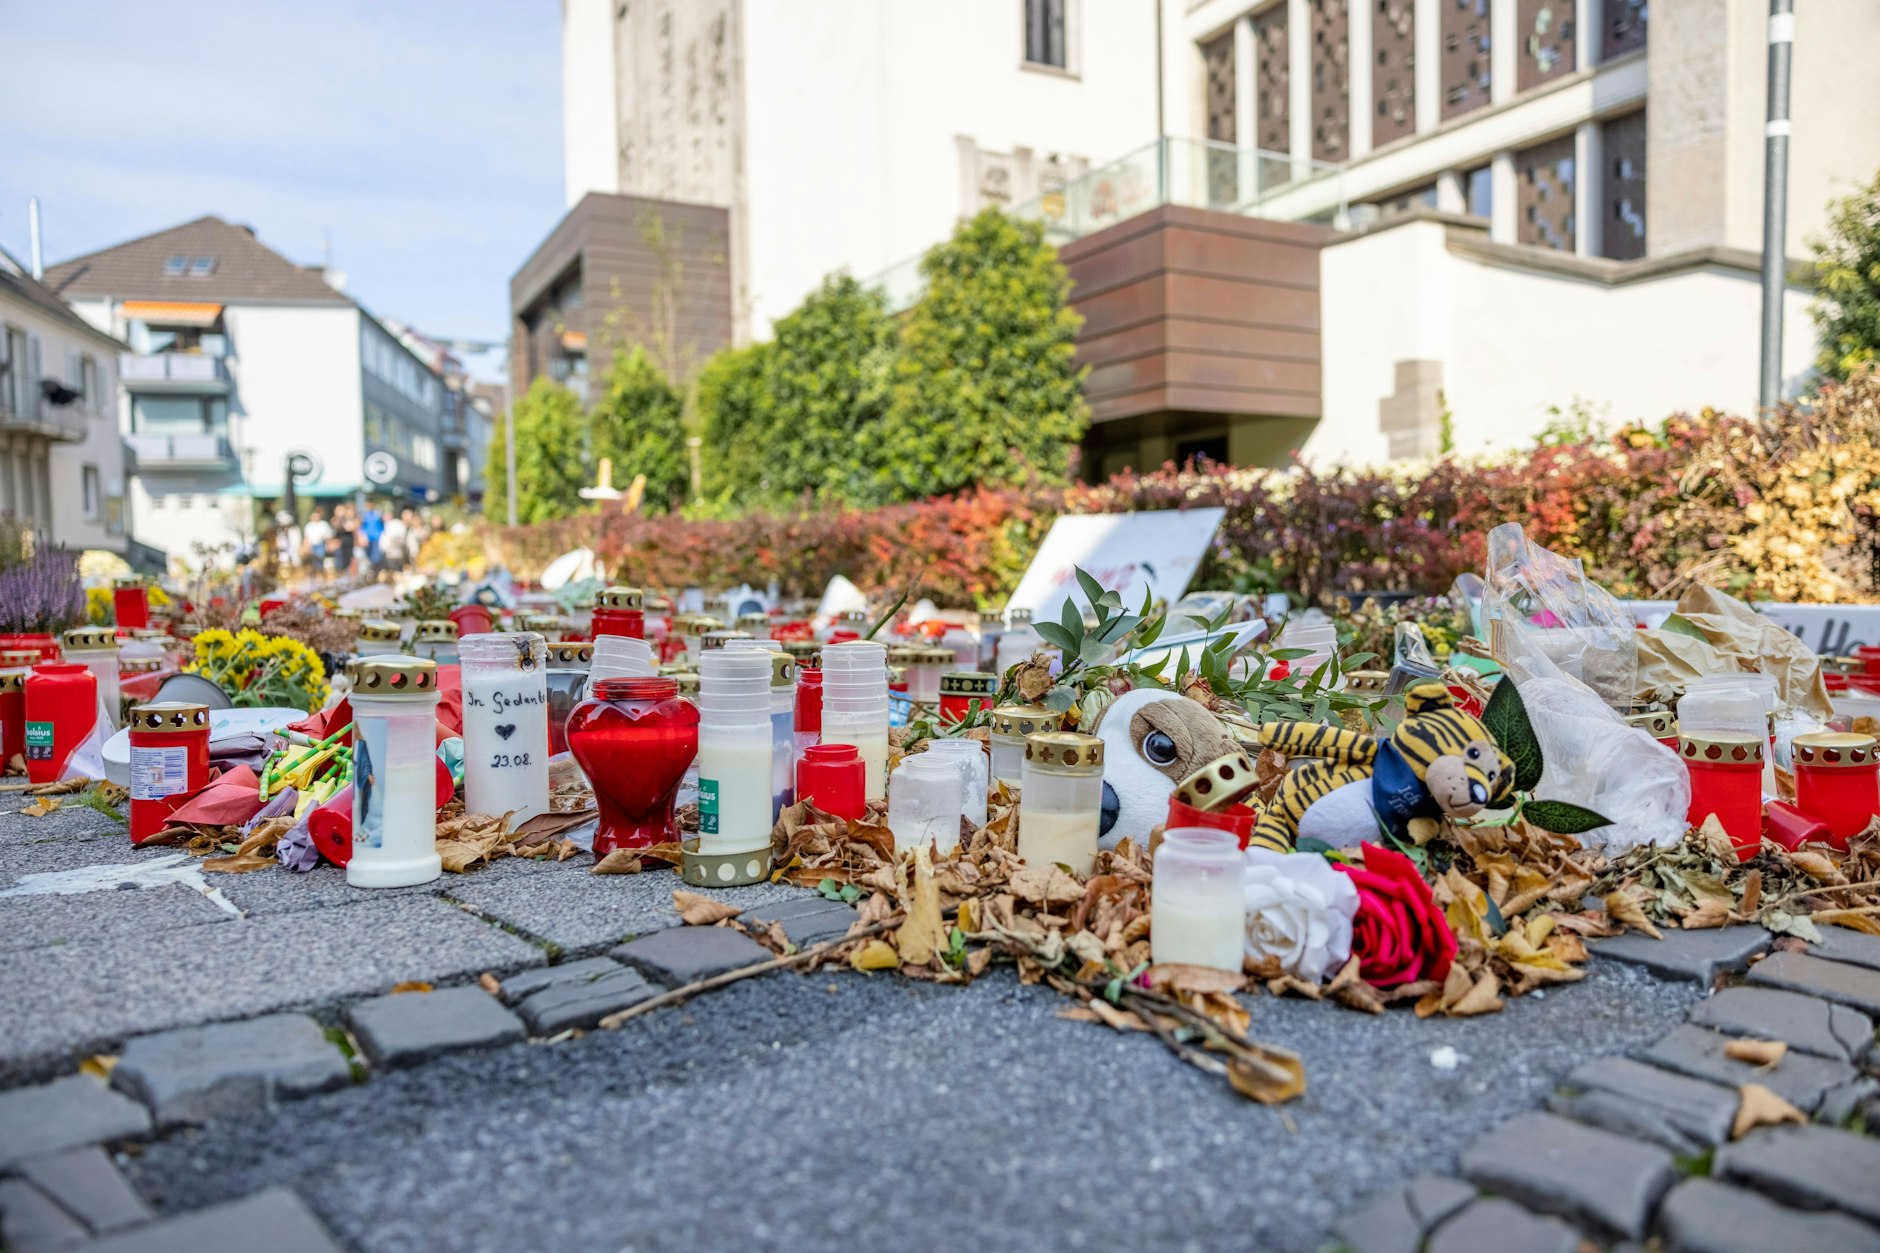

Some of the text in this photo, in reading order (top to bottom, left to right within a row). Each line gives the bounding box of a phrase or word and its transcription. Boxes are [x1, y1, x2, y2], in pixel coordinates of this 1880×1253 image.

[467, 690, 485, 707] In
[490, 752, 532, 768] 23.08.
[1397, 785, 1422, 806] Ich
